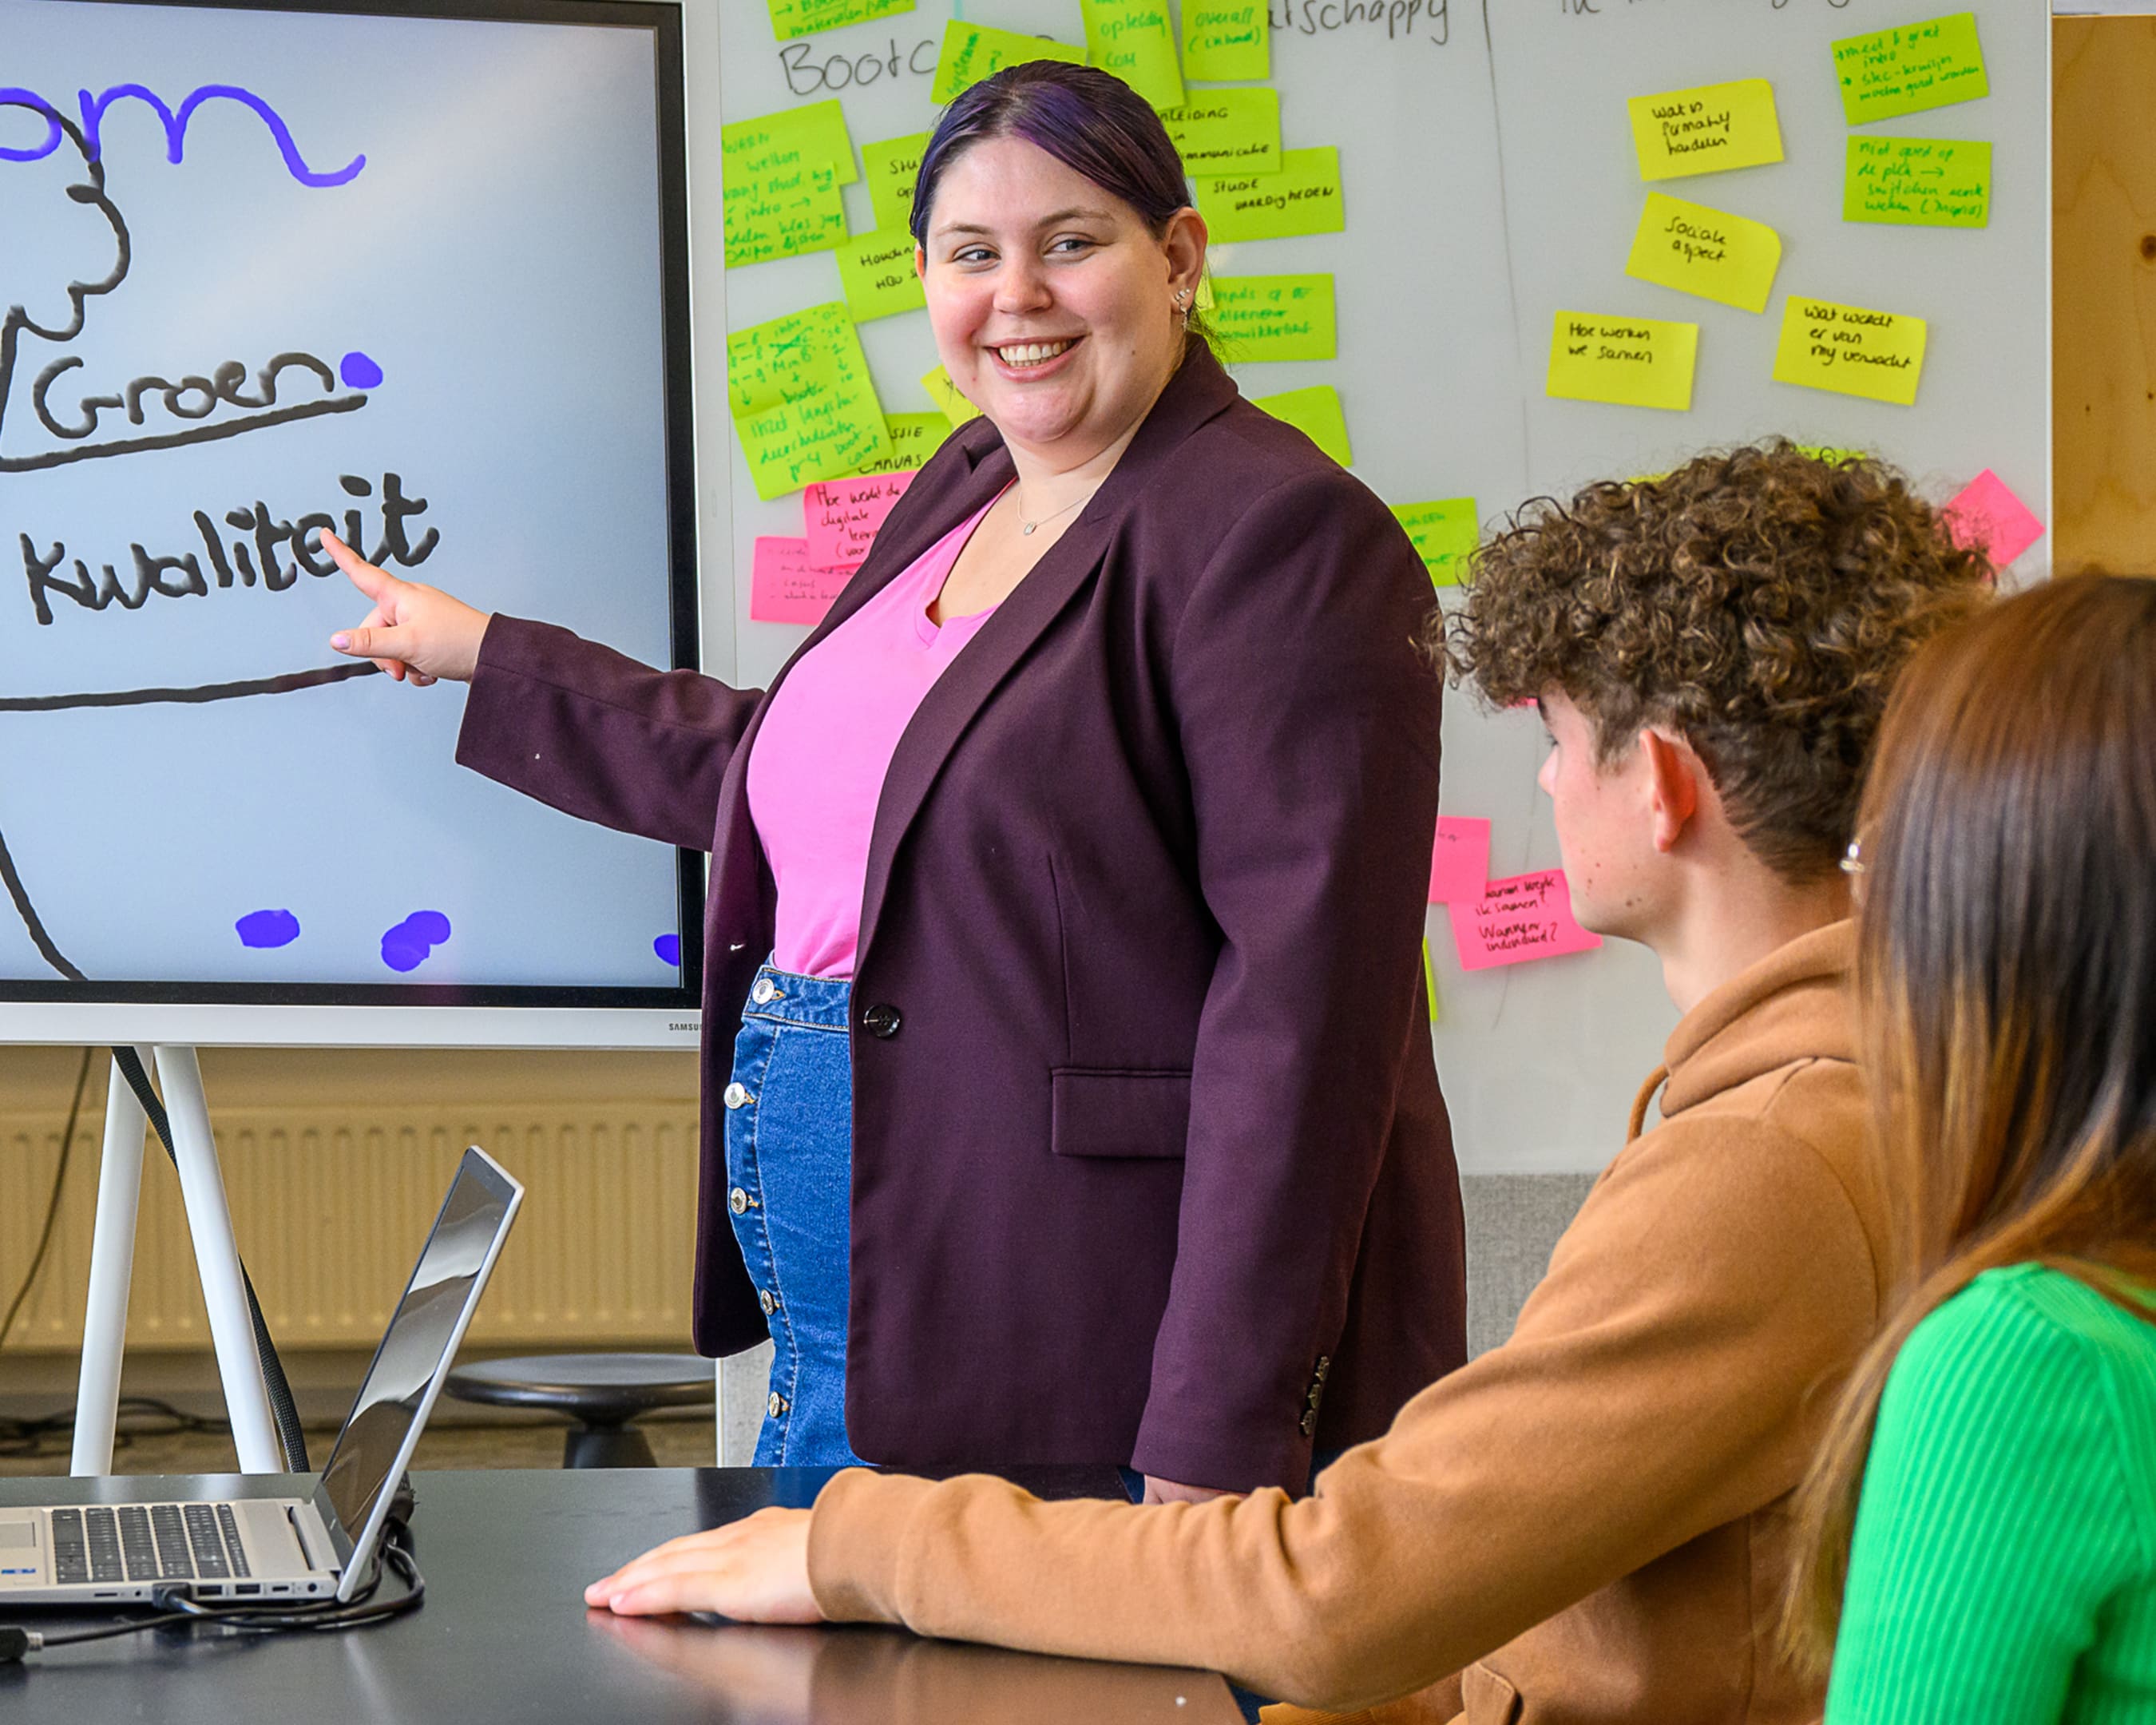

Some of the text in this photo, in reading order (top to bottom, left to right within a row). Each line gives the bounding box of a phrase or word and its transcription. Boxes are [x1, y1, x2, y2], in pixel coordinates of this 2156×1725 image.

[779, 38, 936, 96] BootC
[1833, 331, 1863, 344] van
[890, 426, 924, 440] SSIE
[669, 1022, 702, 1032] SAMSU
